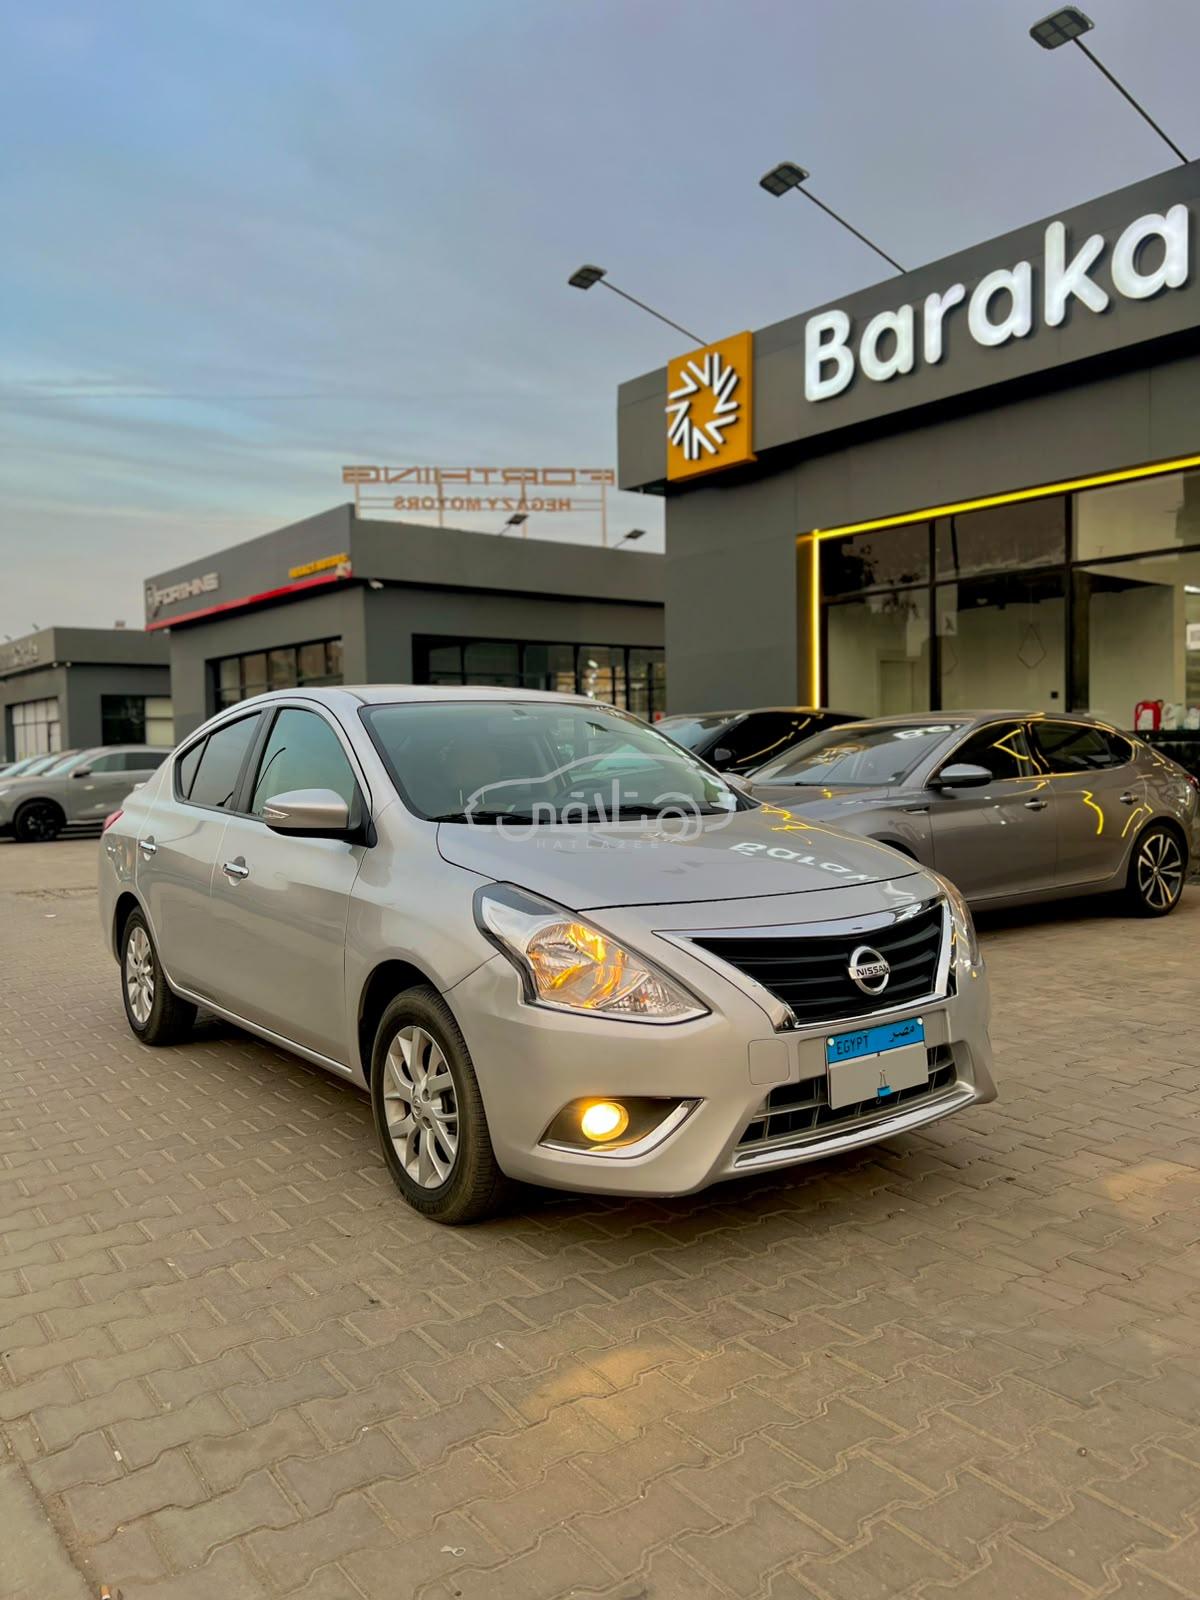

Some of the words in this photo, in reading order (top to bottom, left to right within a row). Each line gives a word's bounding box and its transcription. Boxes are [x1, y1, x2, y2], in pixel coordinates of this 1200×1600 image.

[804, 203, 1189, 402] Baraka
[856, 963, 890, 977] NISSAN
[889, 1025, 915, 1042] مصر
[836, 1035, 869, 1055] EGYPT
